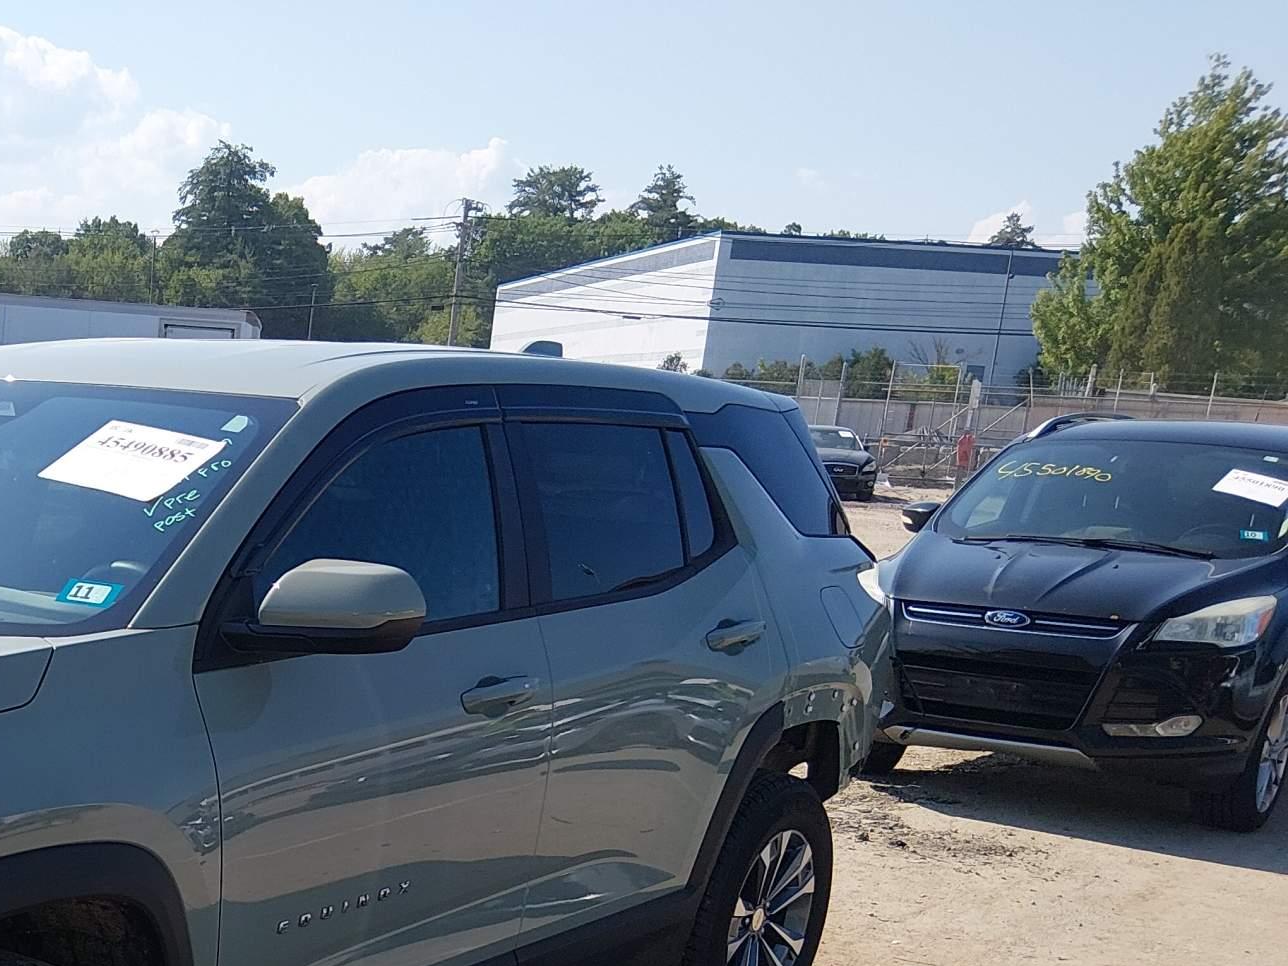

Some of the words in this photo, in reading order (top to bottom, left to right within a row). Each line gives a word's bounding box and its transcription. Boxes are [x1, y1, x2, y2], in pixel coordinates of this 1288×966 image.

[98, 435, 194, 463] 45490885
[69, 584, 95, 600] 11
[276, 879, 411, 935] EQUINOX
